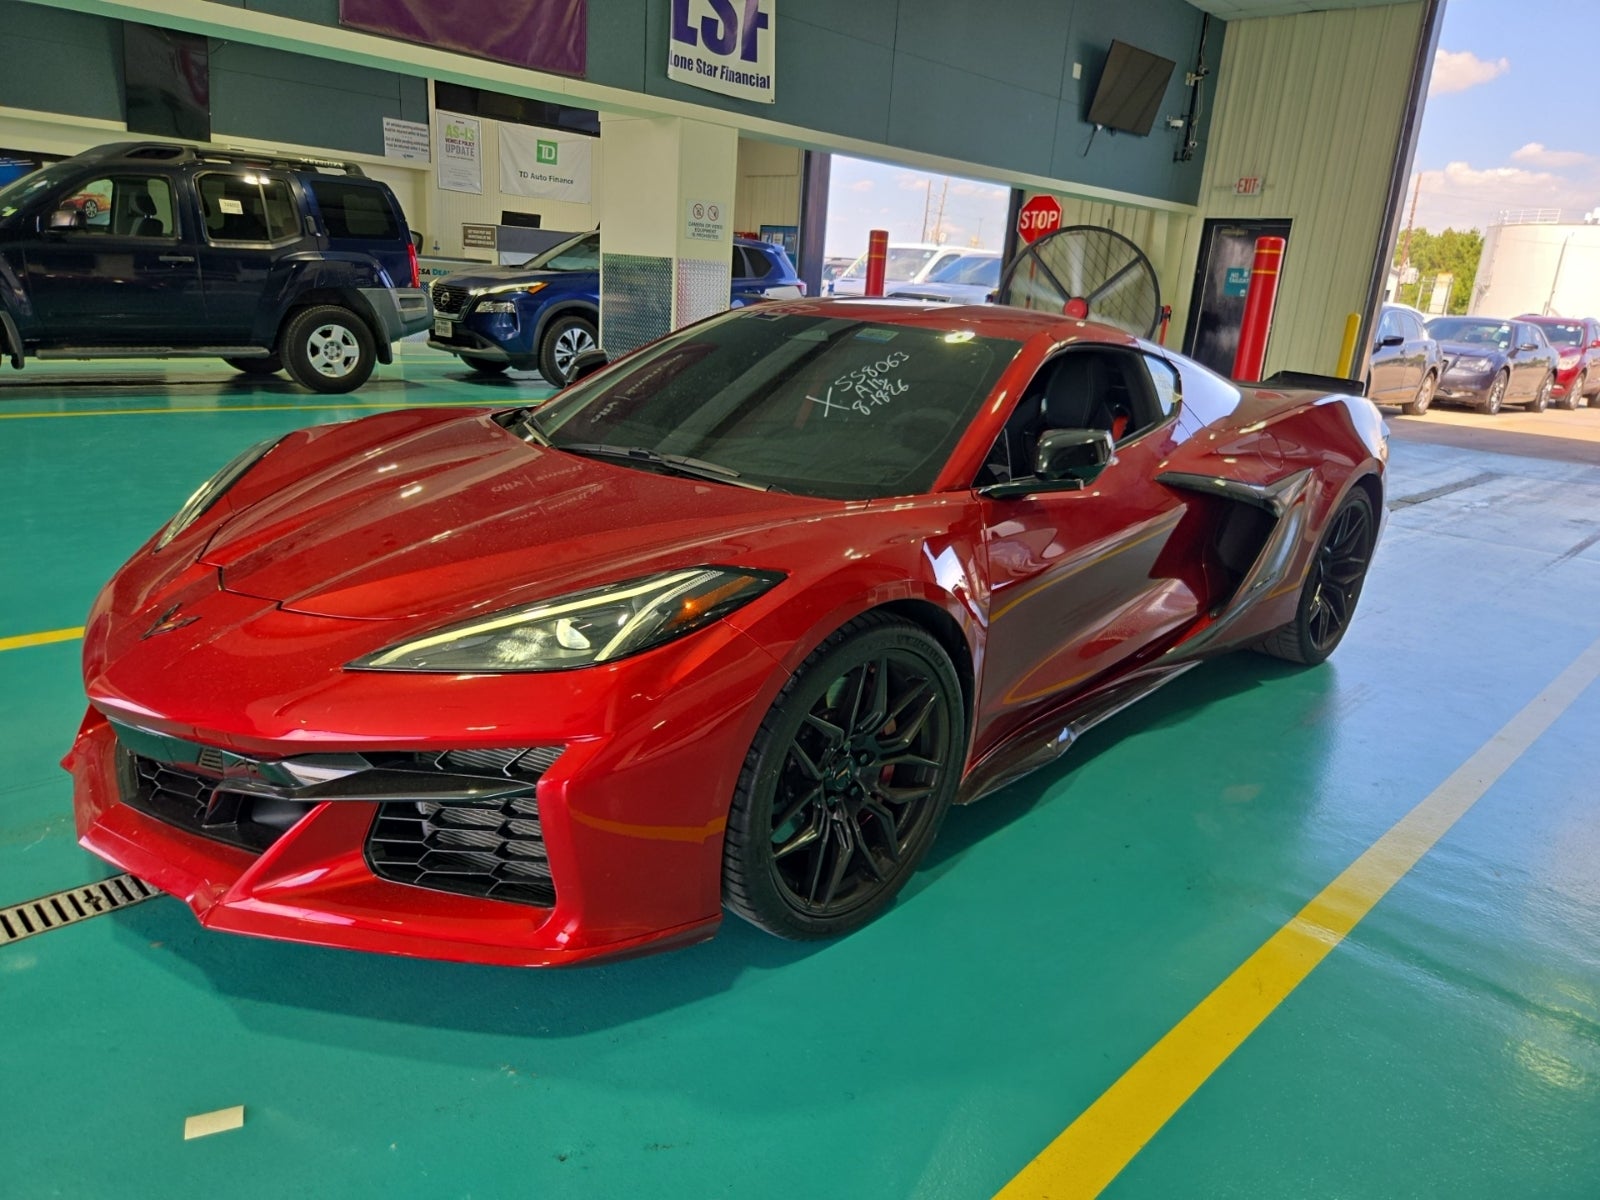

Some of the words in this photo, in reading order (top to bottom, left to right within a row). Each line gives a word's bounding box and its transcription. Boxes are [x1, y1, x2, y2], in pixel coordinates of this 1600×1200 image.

[670, 50, 694, 72] Lone
[696, 58, 719, 78] Star
[720, 64, 771, 90] Financial
[445, 143, 475, 157] UPDATE
[538, 143, 556, 161] TD
[519, 170, 529, 179] TD
[530, 172, 548, 182] Auto
[548, 175, 575, 185] Finance
[1237, 176, 1258, 194] EXIT
[1020, 209, 1059, 230] STOP
